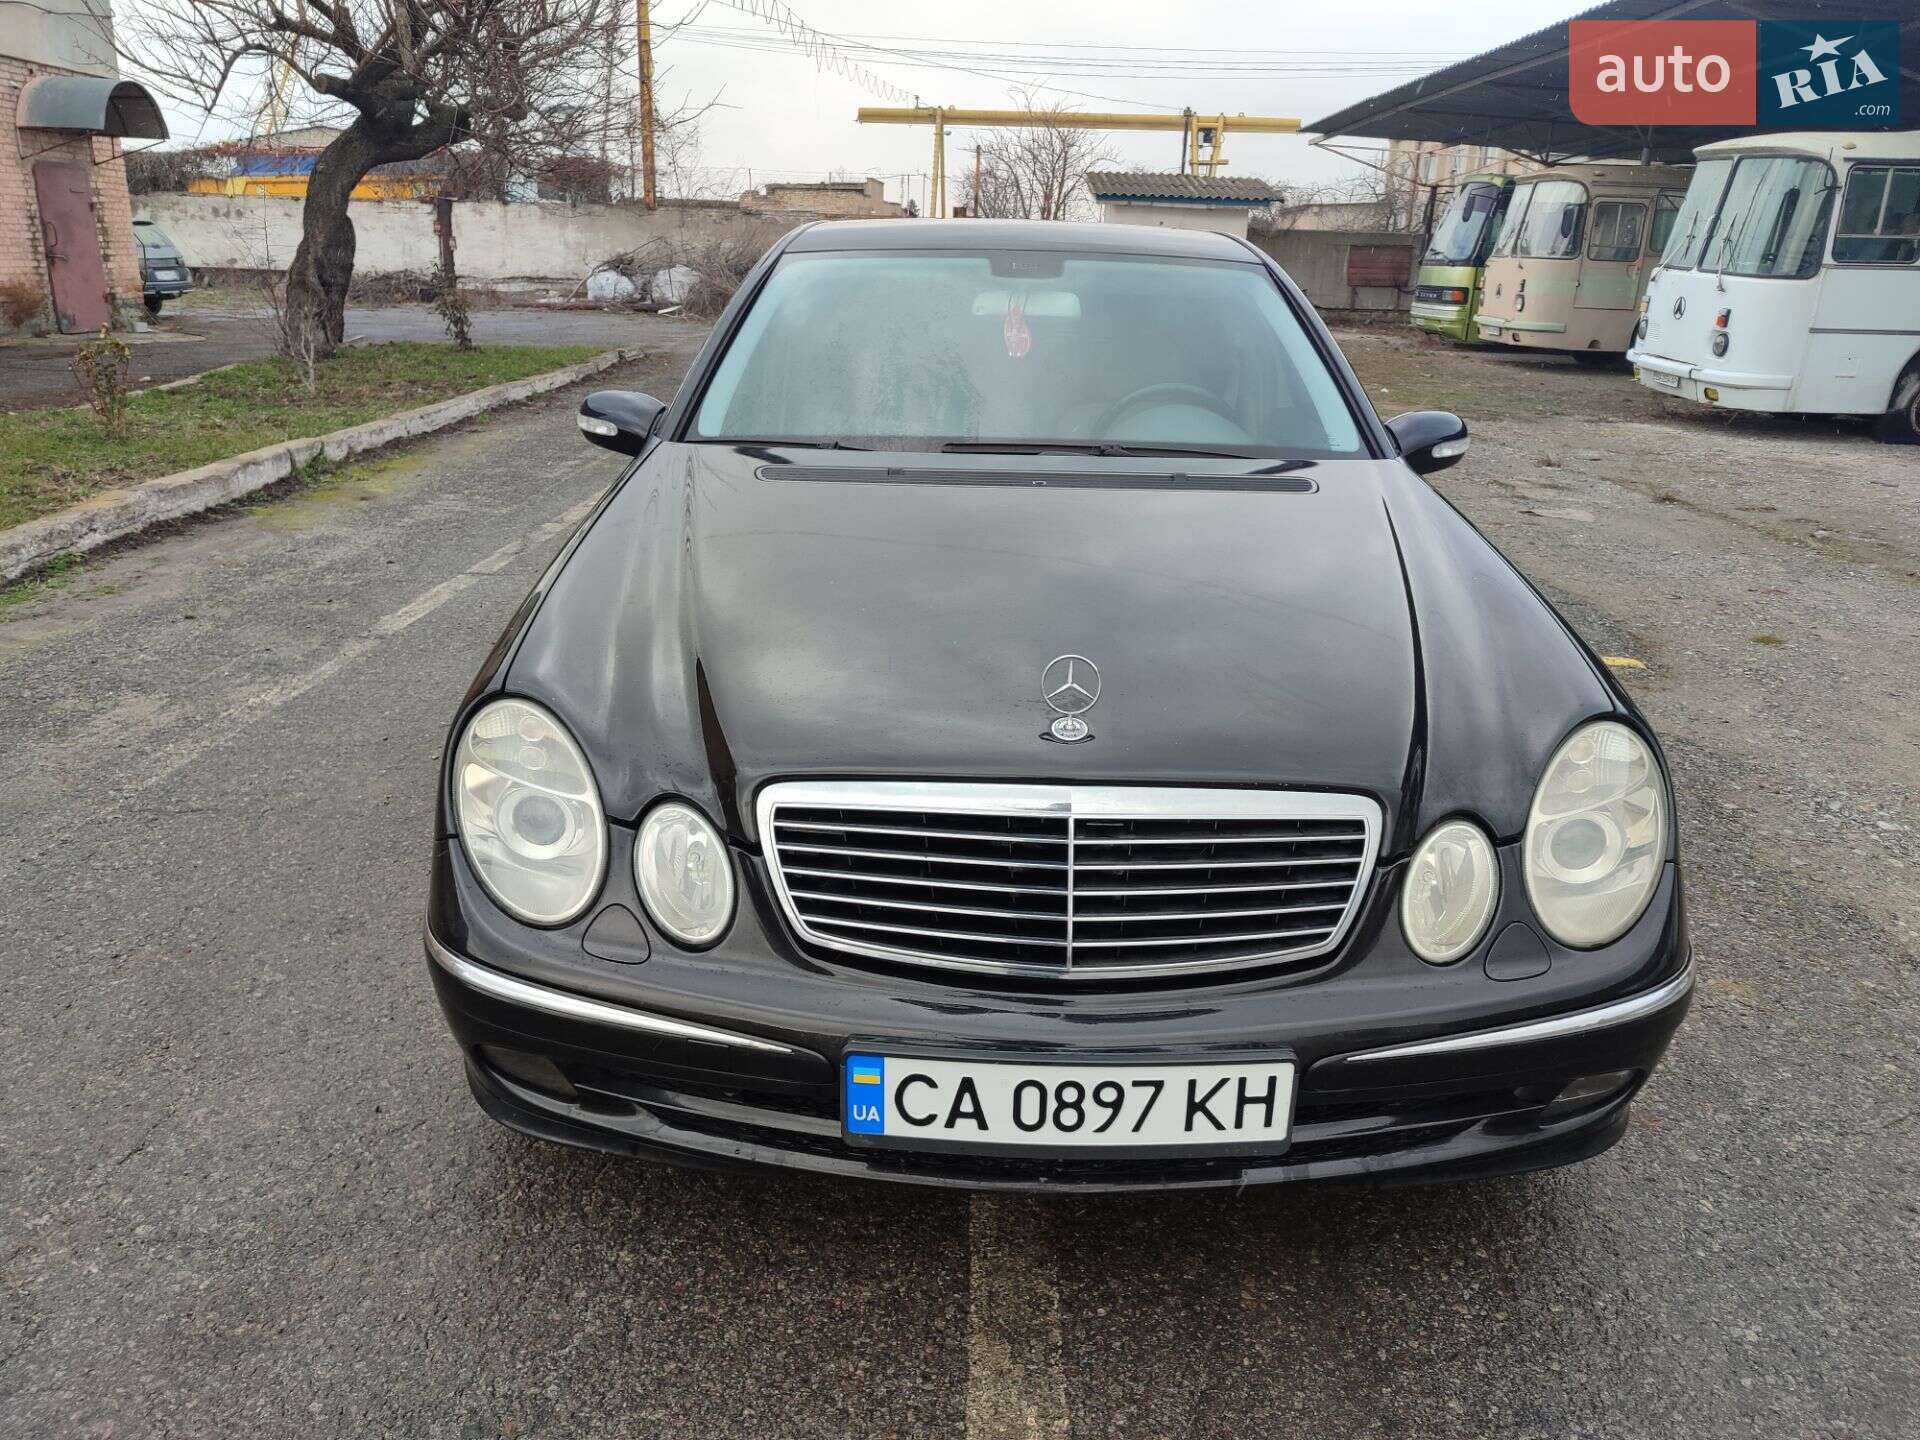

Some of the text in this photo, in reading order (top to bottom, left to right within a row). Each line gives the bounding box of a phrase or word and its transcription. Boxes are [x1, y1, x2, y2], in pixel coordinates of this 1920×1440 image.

[852, 1104, 881, 1122] UA
[894, 1073, 1277, 1133] CA 0897 KH
